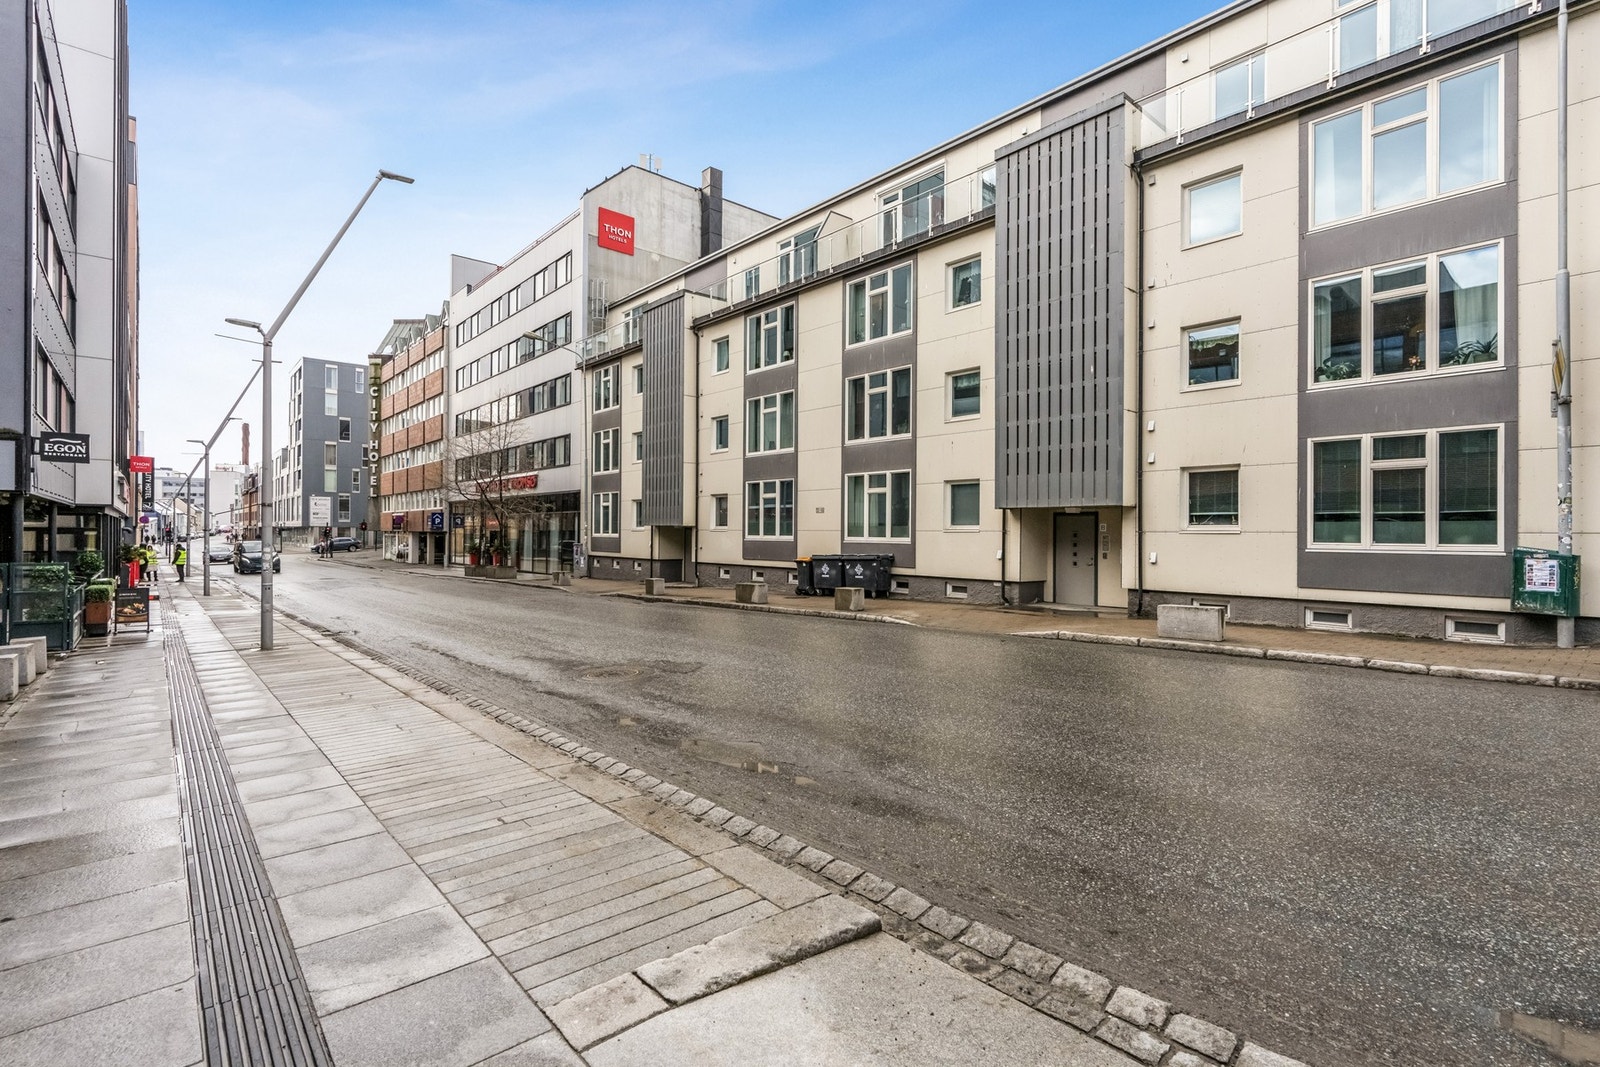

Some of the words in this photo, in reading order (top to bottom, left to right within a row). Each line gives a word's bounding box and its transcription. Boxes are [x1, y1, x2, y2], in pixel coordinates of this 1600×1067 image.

[603, 223, 632, 239] THON
[608, 234, 627, 244] HOTELS
[370, 386, 379, 433] CITY
[44, 443, 86, 454] EGON
[369, 439, 379, 498] HOTEL
